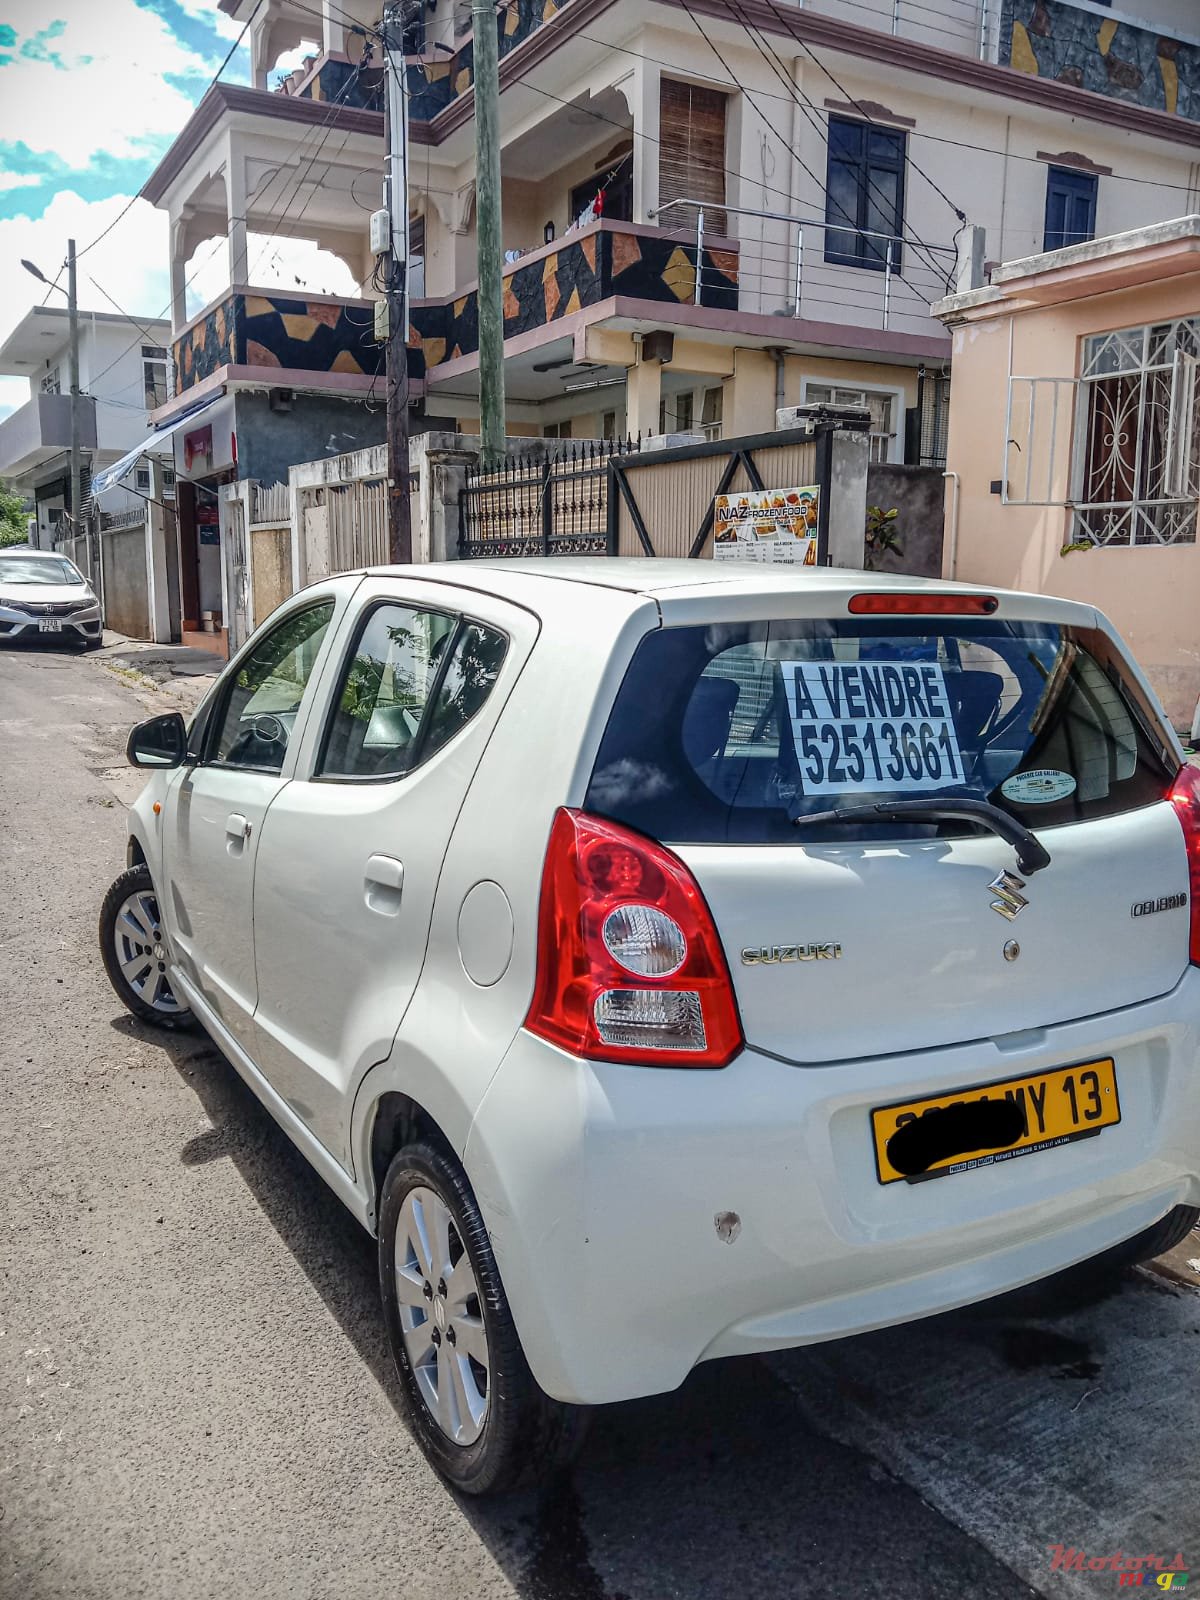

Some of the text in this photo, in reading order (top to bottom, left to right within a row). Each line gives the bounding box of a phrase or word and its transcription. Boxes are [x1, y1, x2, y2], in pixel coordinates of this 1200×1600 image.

[720, 506, 806, 520] NAZ FROZEN FOOD
[794, 665, 945, 720] A VENDRE
[800, 721, 959, 785] 52513661
[741, 942, 841, 966] SUZUKI
[1062, 1070, 1102, 1125] 13
